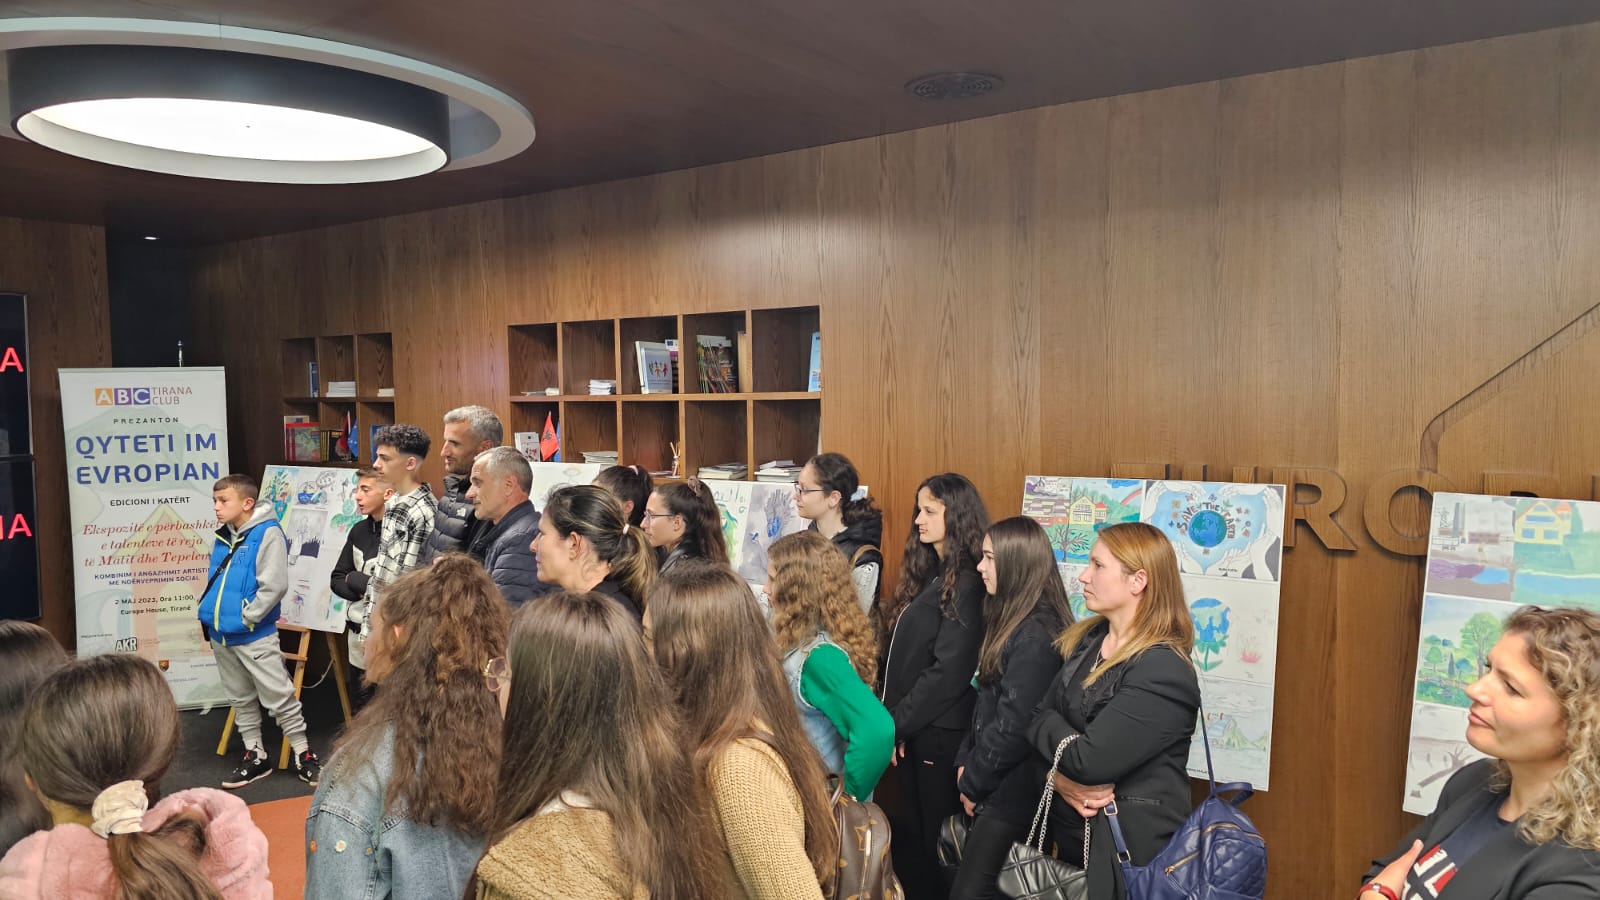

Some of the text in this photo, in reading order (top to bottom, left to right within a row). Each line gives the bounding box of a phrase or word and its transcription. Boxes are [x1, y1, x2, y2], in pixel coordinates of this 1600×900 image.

[95, 387, 193, 405] ABC TIRANA
[151, 396, 181, 405] CLUB
[113, 417, 180, 425] PREZANTON
[75, 433, 217, 460] QYTETI IM
[76, 462, 220, 485] EVROPIAN
[110, 499, 150, 507] EDICIONI
[158, 496, 191, 504] KATËRT
[1177, 502, 1236, 539] SAVE THE EARTH
[83, 523, 144, 537] Ekspozitë
[146, 525, 153, 533] e
[101, 535, 204, 551] e talenteve të reja
[84, 557, 96, 568] të
[98, 554, 135, 566] Matit
[136, 553, 159, 565] dhe
[94, 572, 132, 580] KOMBINIM
[138, 569, 180, 577] ANGAZHIMIT
[182, 567, 209, 575] ARTISTI
[120, 604, 192, 617] Europe House, Tiranë
[115, 637, 138, 652] AKR
